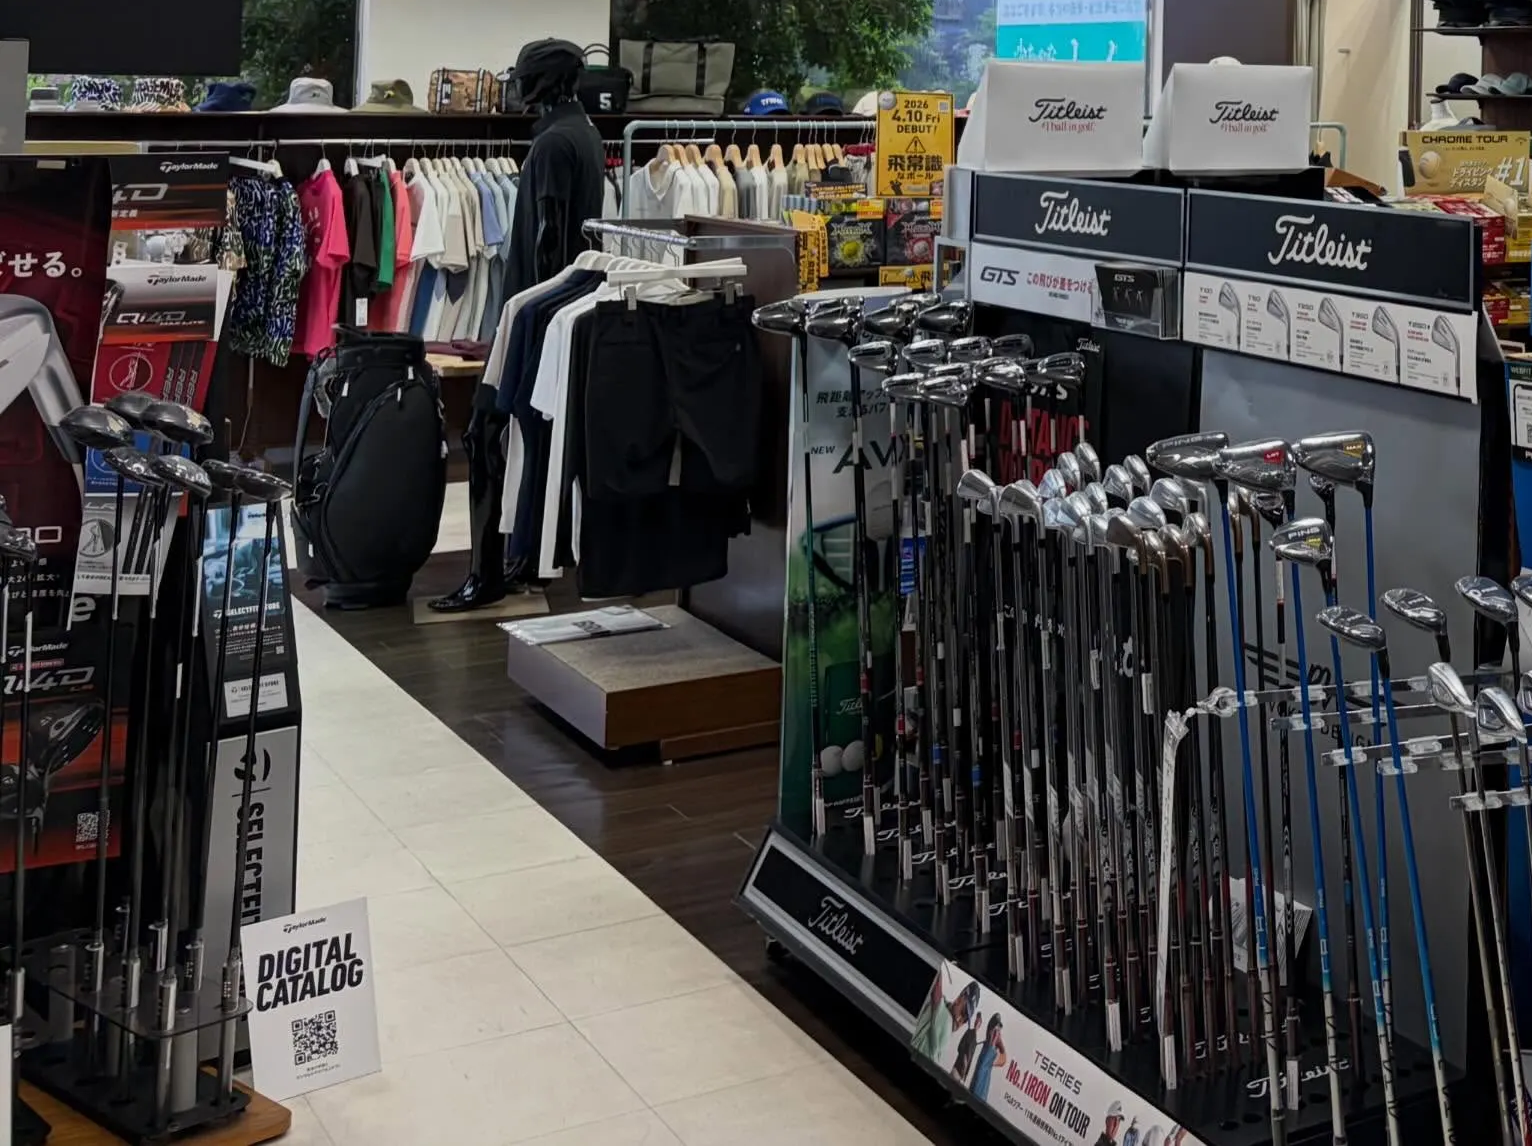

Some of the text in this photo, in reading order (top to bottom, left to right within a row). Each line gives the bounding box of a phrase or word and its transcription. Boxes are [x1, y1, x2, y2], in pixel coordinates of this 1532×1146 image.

[904, 100, 928, 109] 2026
[1029, 98, 1108, 123] Titleist
[1209, 100, 1280, 124] Titleist
[892, 110, 940, 124] 4.10 Fri
[1052, 121, 1067, 132] ball
[1421, 135, 1508, 144] CHROME TOUR
[159, 161, 219, 174] TaylorMade
[888, 155, 943, 171] 飛常識
[1494, 156, 1526, 186] #1
[897, 173, 934, 181] なボール
[1452, 168, 1494, 178] ドライビング
[1035, 191, 1111, 236] Titleist
[1267, 214, 1372, 271] Titleist
[0, 252, 83, 278] せる。
[147, 274, 207, 286] TaylorMade
[980, 265, 1020, 286] GTS
[1114, 273, 1136, 284] GTS
[811, 445, 836, 455] NEW
[1287, 527, 1320, 539] PING
[283, 917, 328, 933] TaylorMade
[808, 896, 865, 955] Titleist
[257, 932, 357, 984] DIGITAL
[256, 958, 364, 1013] CATALOG
[1049, 1092, 1067, 1121] ON
[1064, 1101, 1091, 1139] TOUR
